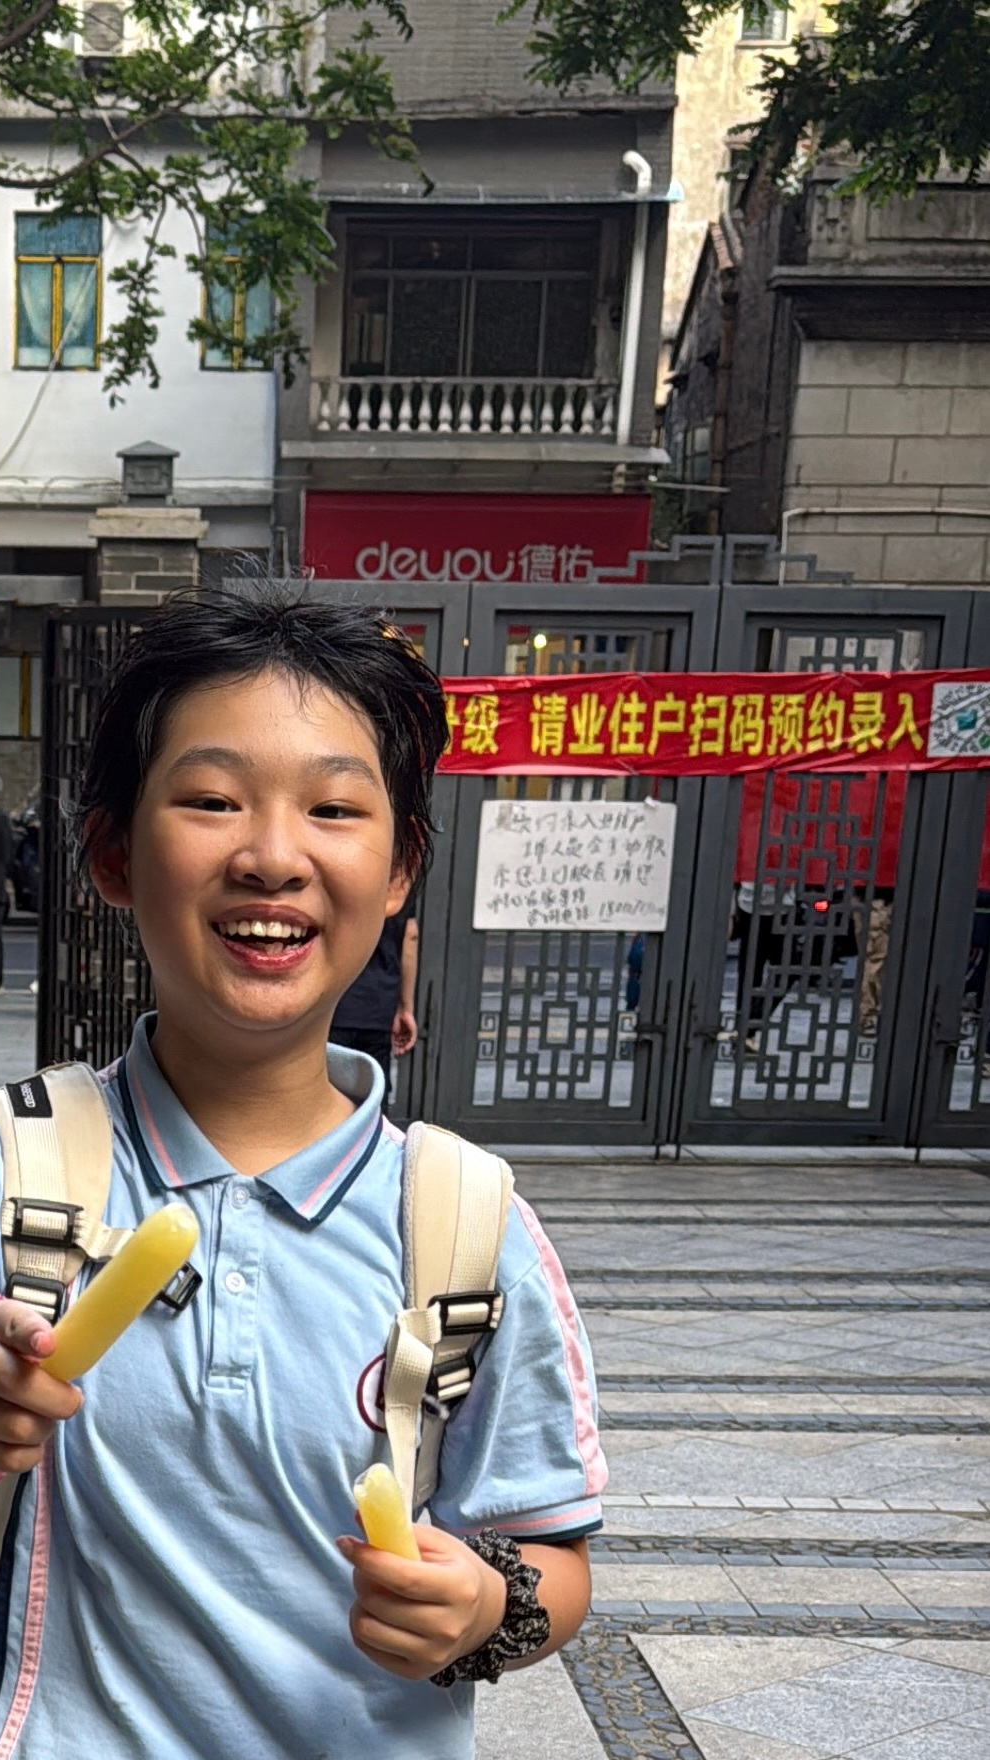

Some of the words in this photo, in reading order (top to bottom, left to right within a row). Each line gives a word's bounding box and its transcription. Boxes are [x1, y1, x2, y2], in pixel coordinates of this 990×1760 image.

[518, 544, 594, 584] 德佑
[530, 691, 924, 757] 请业住户扫码预约录入
